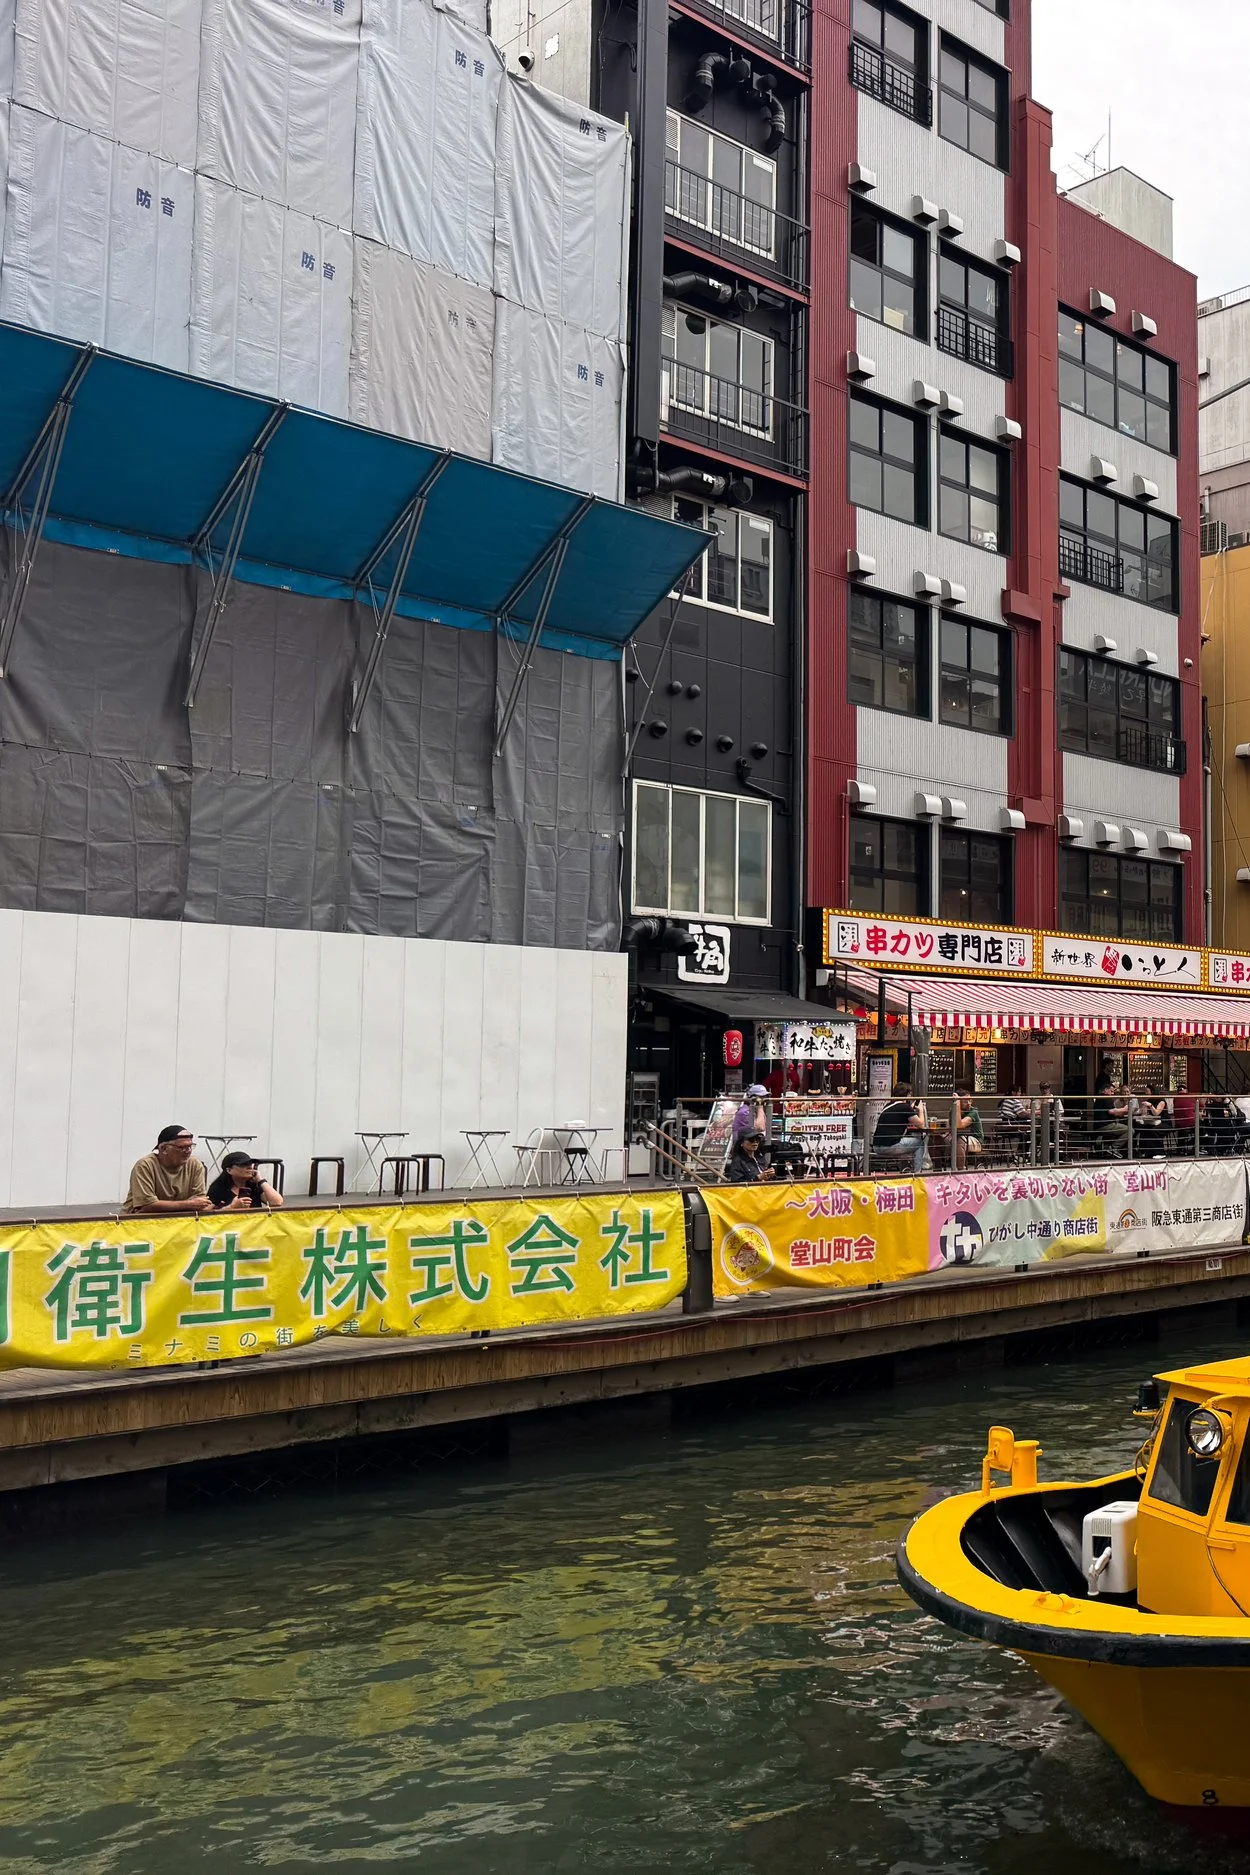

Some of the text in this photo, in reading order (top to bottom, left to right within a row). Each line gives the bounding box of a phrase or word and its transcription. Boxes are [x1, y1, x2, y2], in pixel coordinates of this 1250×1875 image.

[455, 50, 486, 77] 防音
[579, 118, 608, 143] 防音
[135, 187, 176, 217] 防音
[301, 250, 337, 281] 防音
[577, 363, 604, 387] 防音
[866, 925, 1003, 963] 串カツ専門店
[1051, 948, 1098, 968] 新世界
[790, 1031, 851, 1057] 和牛たこ焼き
[826, 1124, 847, 1132] FREE
[1151, 1204, 1243, 1227] 阪急東通第三商店街
[989, 1217, 1098, 1242] ひがし中通り商店街
[790, 1235, 876, 1267] 堂山町会
[0, 1207, 671, 1345] 衛生株式会社
[128, 1313, 423, 1361] ミナミの街を美しく
[1201, 1789, 1219, 1805] 8
